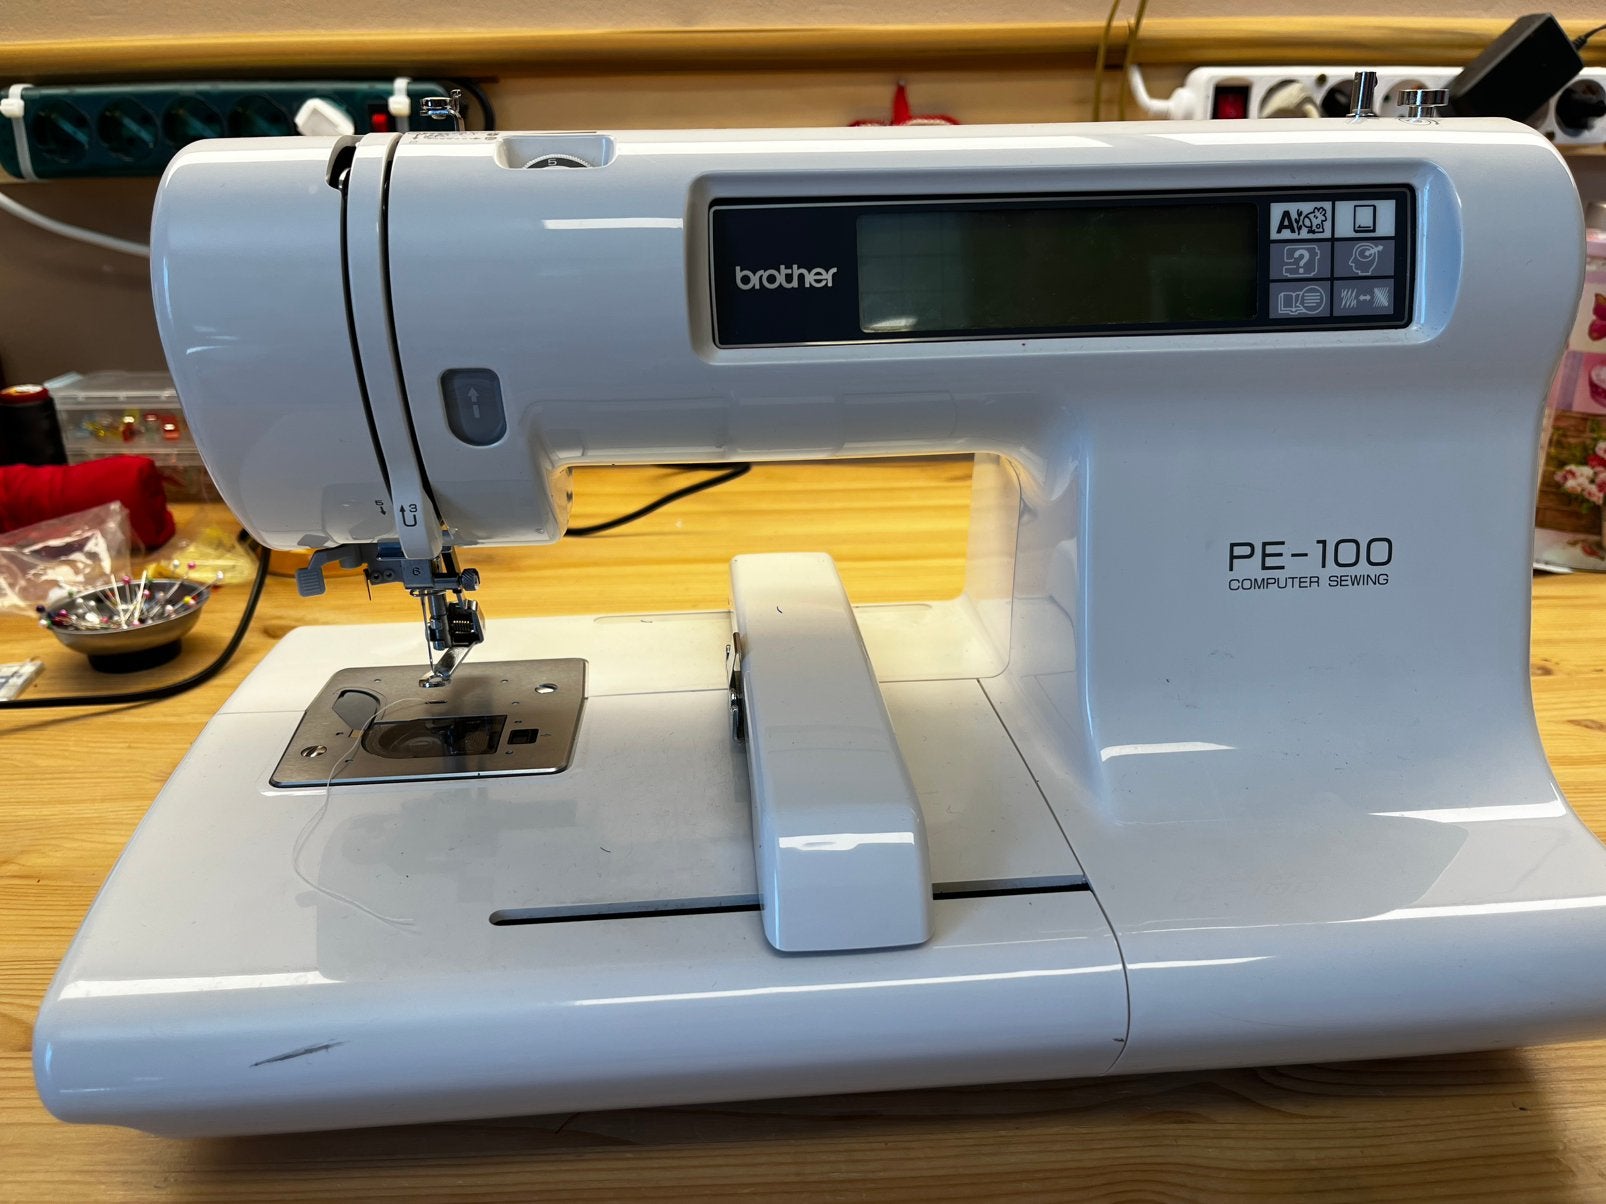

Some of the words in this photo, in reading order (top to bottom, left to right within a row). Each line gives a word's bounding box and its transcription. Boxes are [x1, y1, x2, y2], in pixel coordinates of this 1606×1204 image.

[1276, 210, 1297, 234] A
[735, 264, 837, 291] brother
[408, 503, 418, 513] 3
[1228, 537, 1393, 572] PE-100
[412, 567, 421, 576] 6
[1228, 575, 1320, 591] COMPUTER
[1328, 573, 1389, 588] SEWING
